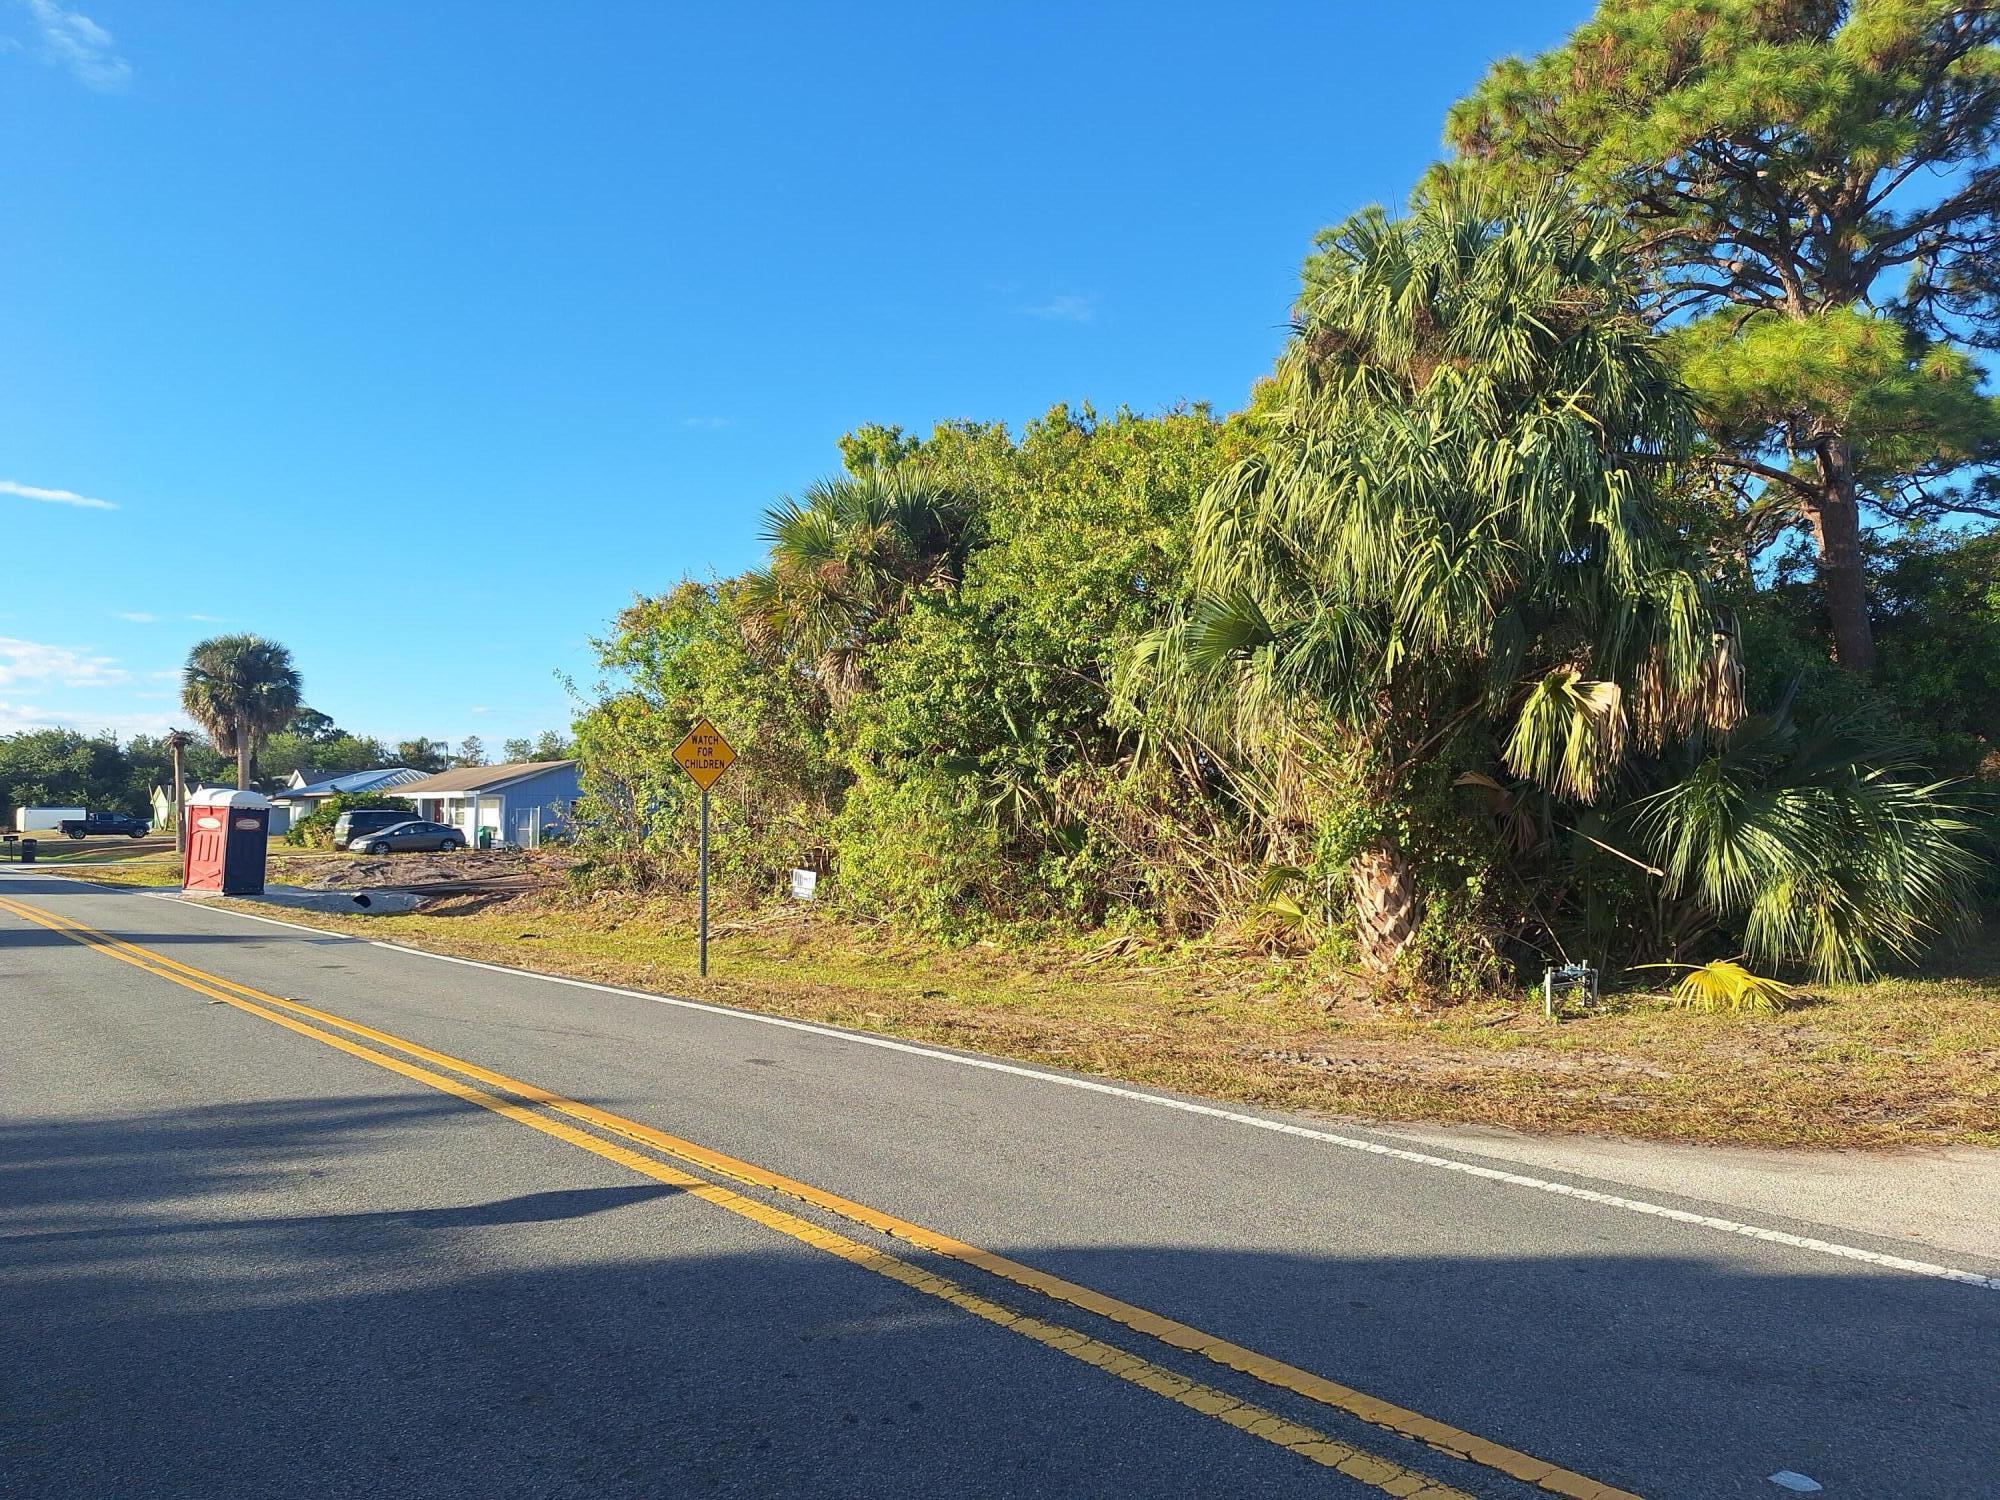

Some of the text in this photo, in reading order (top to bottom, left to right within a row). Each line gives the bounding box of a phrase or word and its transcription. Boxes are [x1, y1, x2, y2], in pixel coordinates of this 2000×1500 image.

[691, 735, 719, 745] WATCH
[697, 747, 713, 757] FOR
[684, 759, 725, 769] CHILDREN
